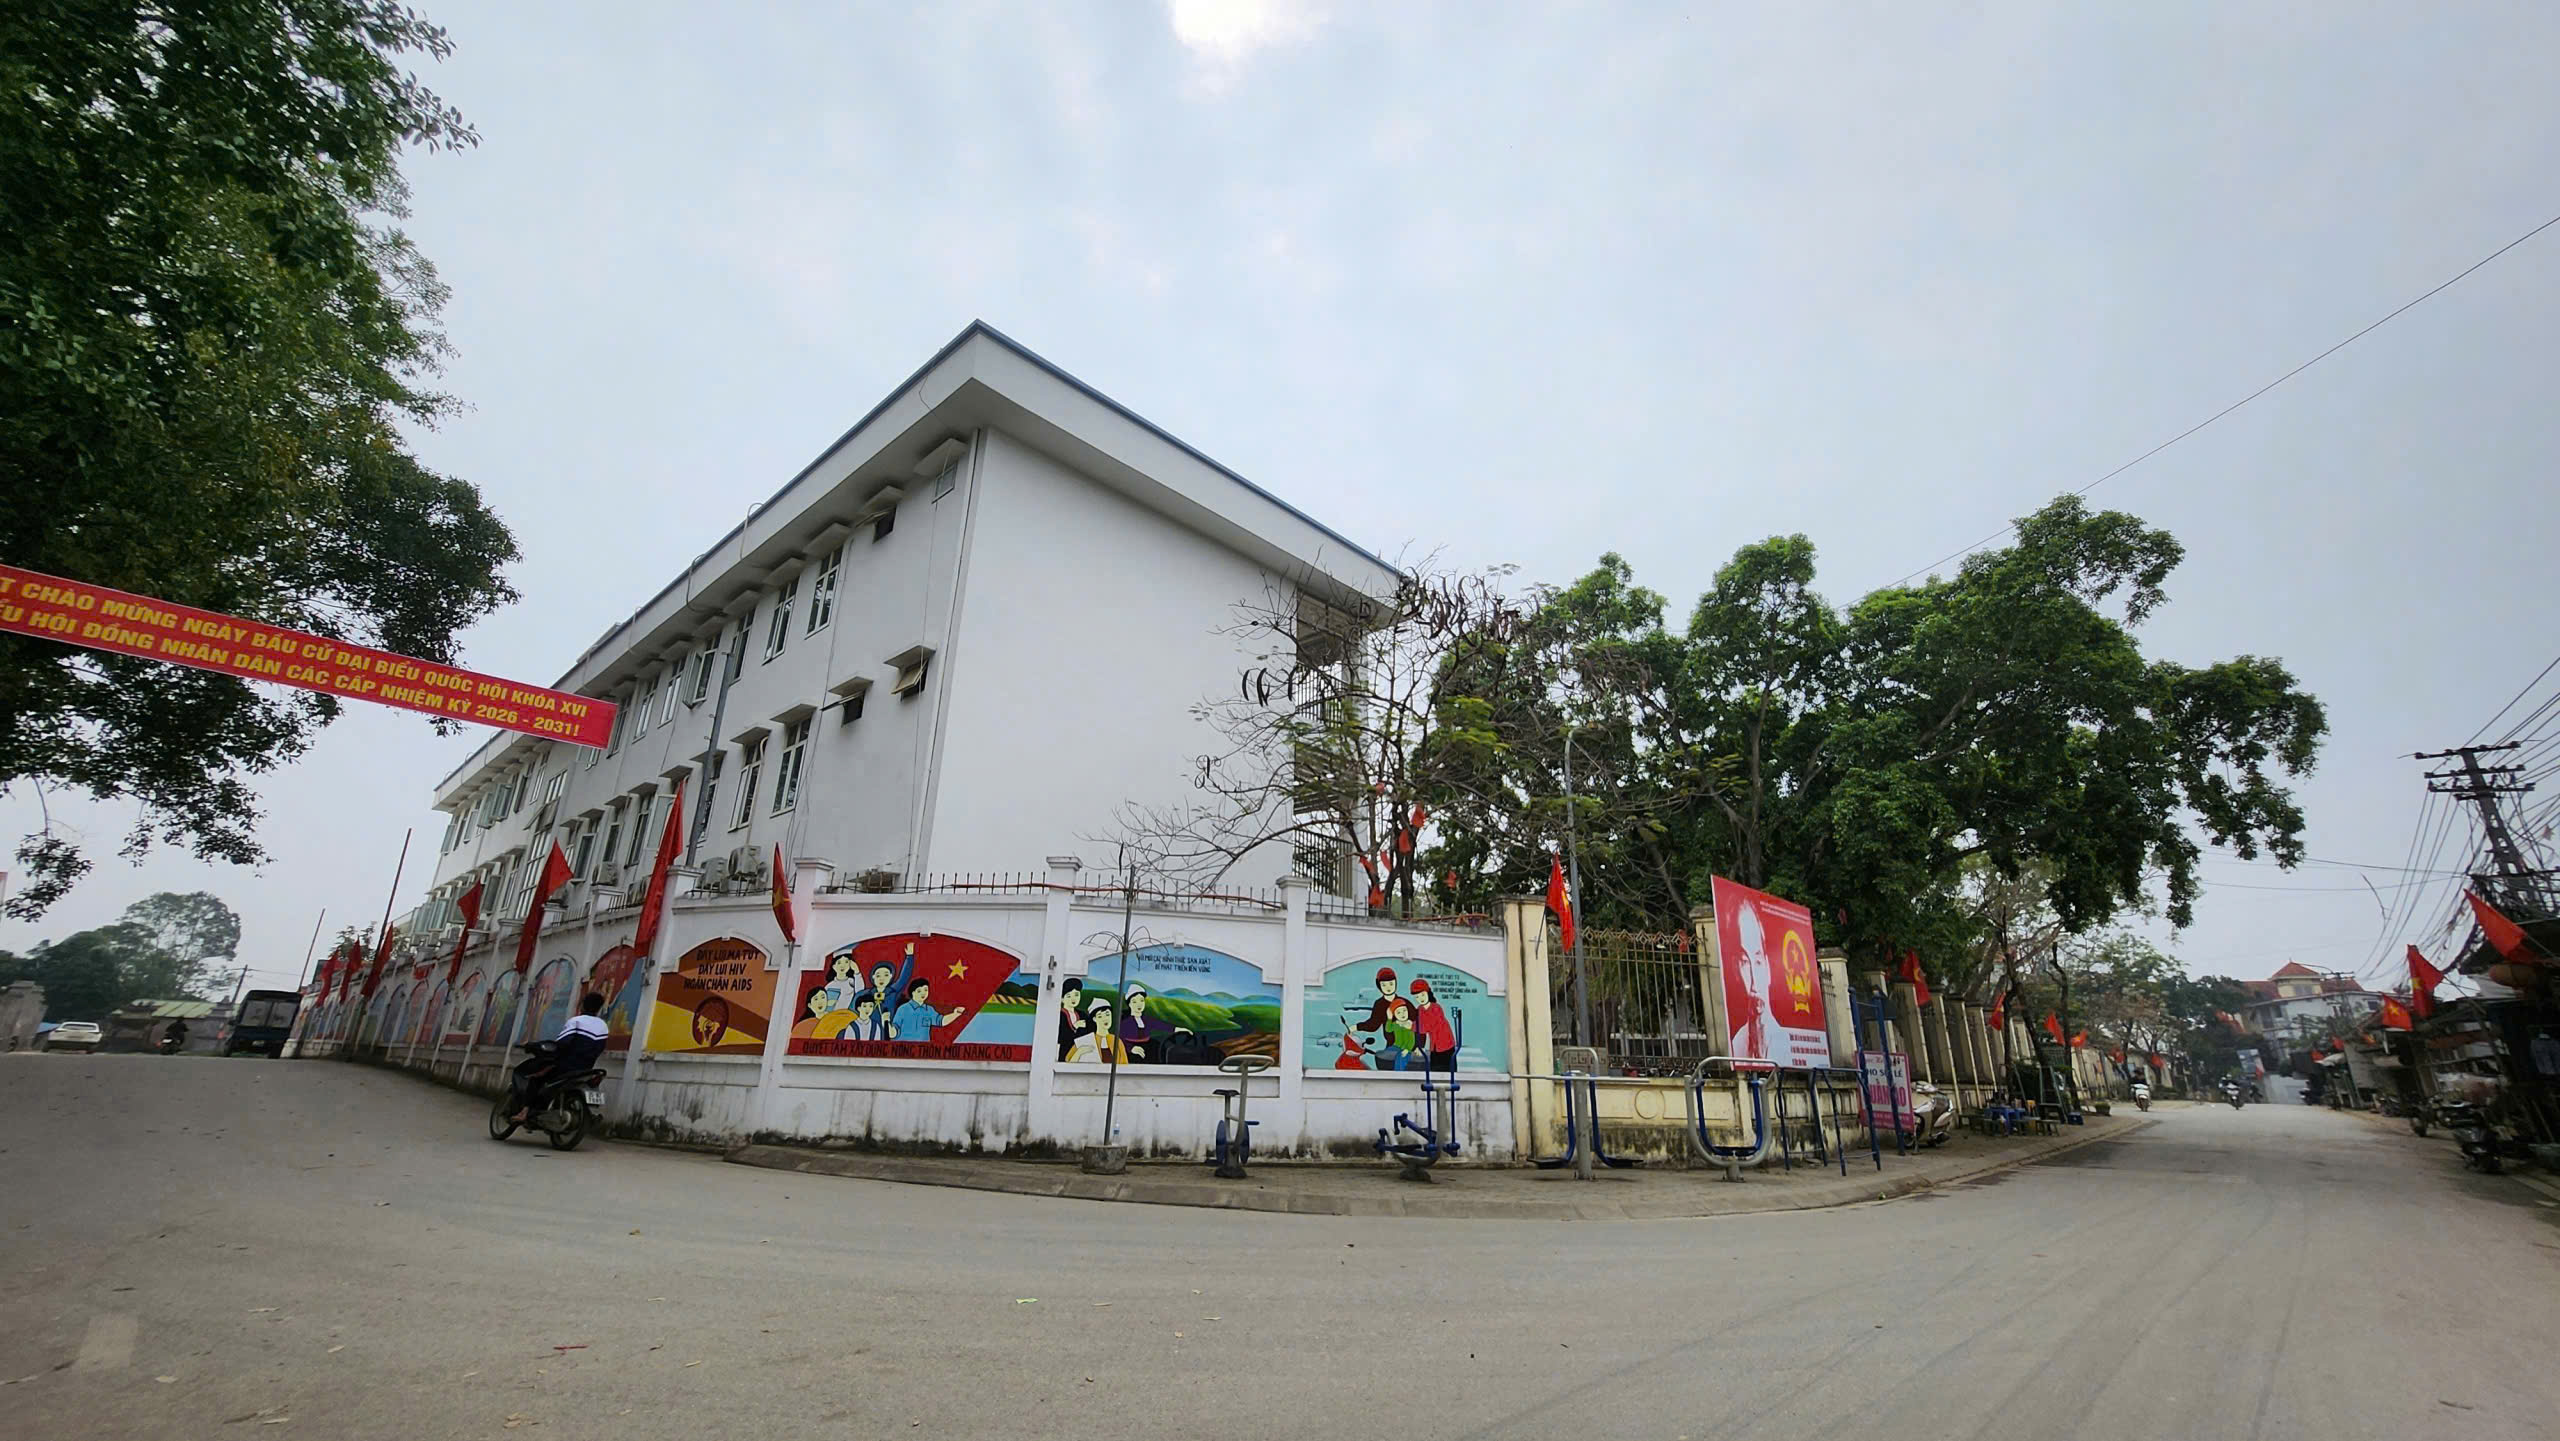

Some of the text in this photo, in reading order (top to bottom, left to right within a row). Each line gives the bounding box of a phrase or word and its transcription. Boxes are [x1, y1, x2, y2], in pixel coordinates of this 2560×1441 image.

[21, 583, 96, 611] CHÀO
[101, 599, 179, 629] MỪNG
[182, 617, 248, 643] NGÀY
[251, 632, 298, 654] BẦU
[301, 643, 334, 662] CỬ
[335, 651, 370, 672] ĐẠI
[375, 659, 420, 681] BIỂU
[424, 671, 474, 693] QUỐC
[477, 682, 508, 701] HỘI
[511, 689, 556, 711] KHÓA
[560, 700, 588, 718] XVI
[29, 611, 78, 634] HỘI
[82, 621, 155, 649] ĐỒNG
[160, 638, 229, 666] NHÂN
[233, 652, 282, 675] DÂN
[286, 664, 330, 685] CÁC
[335, 674, 376, 694] CẤP
[380, 684, 443, 708] NHIỆM
[447, 697, 472, 714] KỲ
[475, 704, 519, 724] 2026
[533, 717, 580, 737] 2031!
[729, 963, 747, 975] HIV
[731, 978, 752, 991] AIDS
